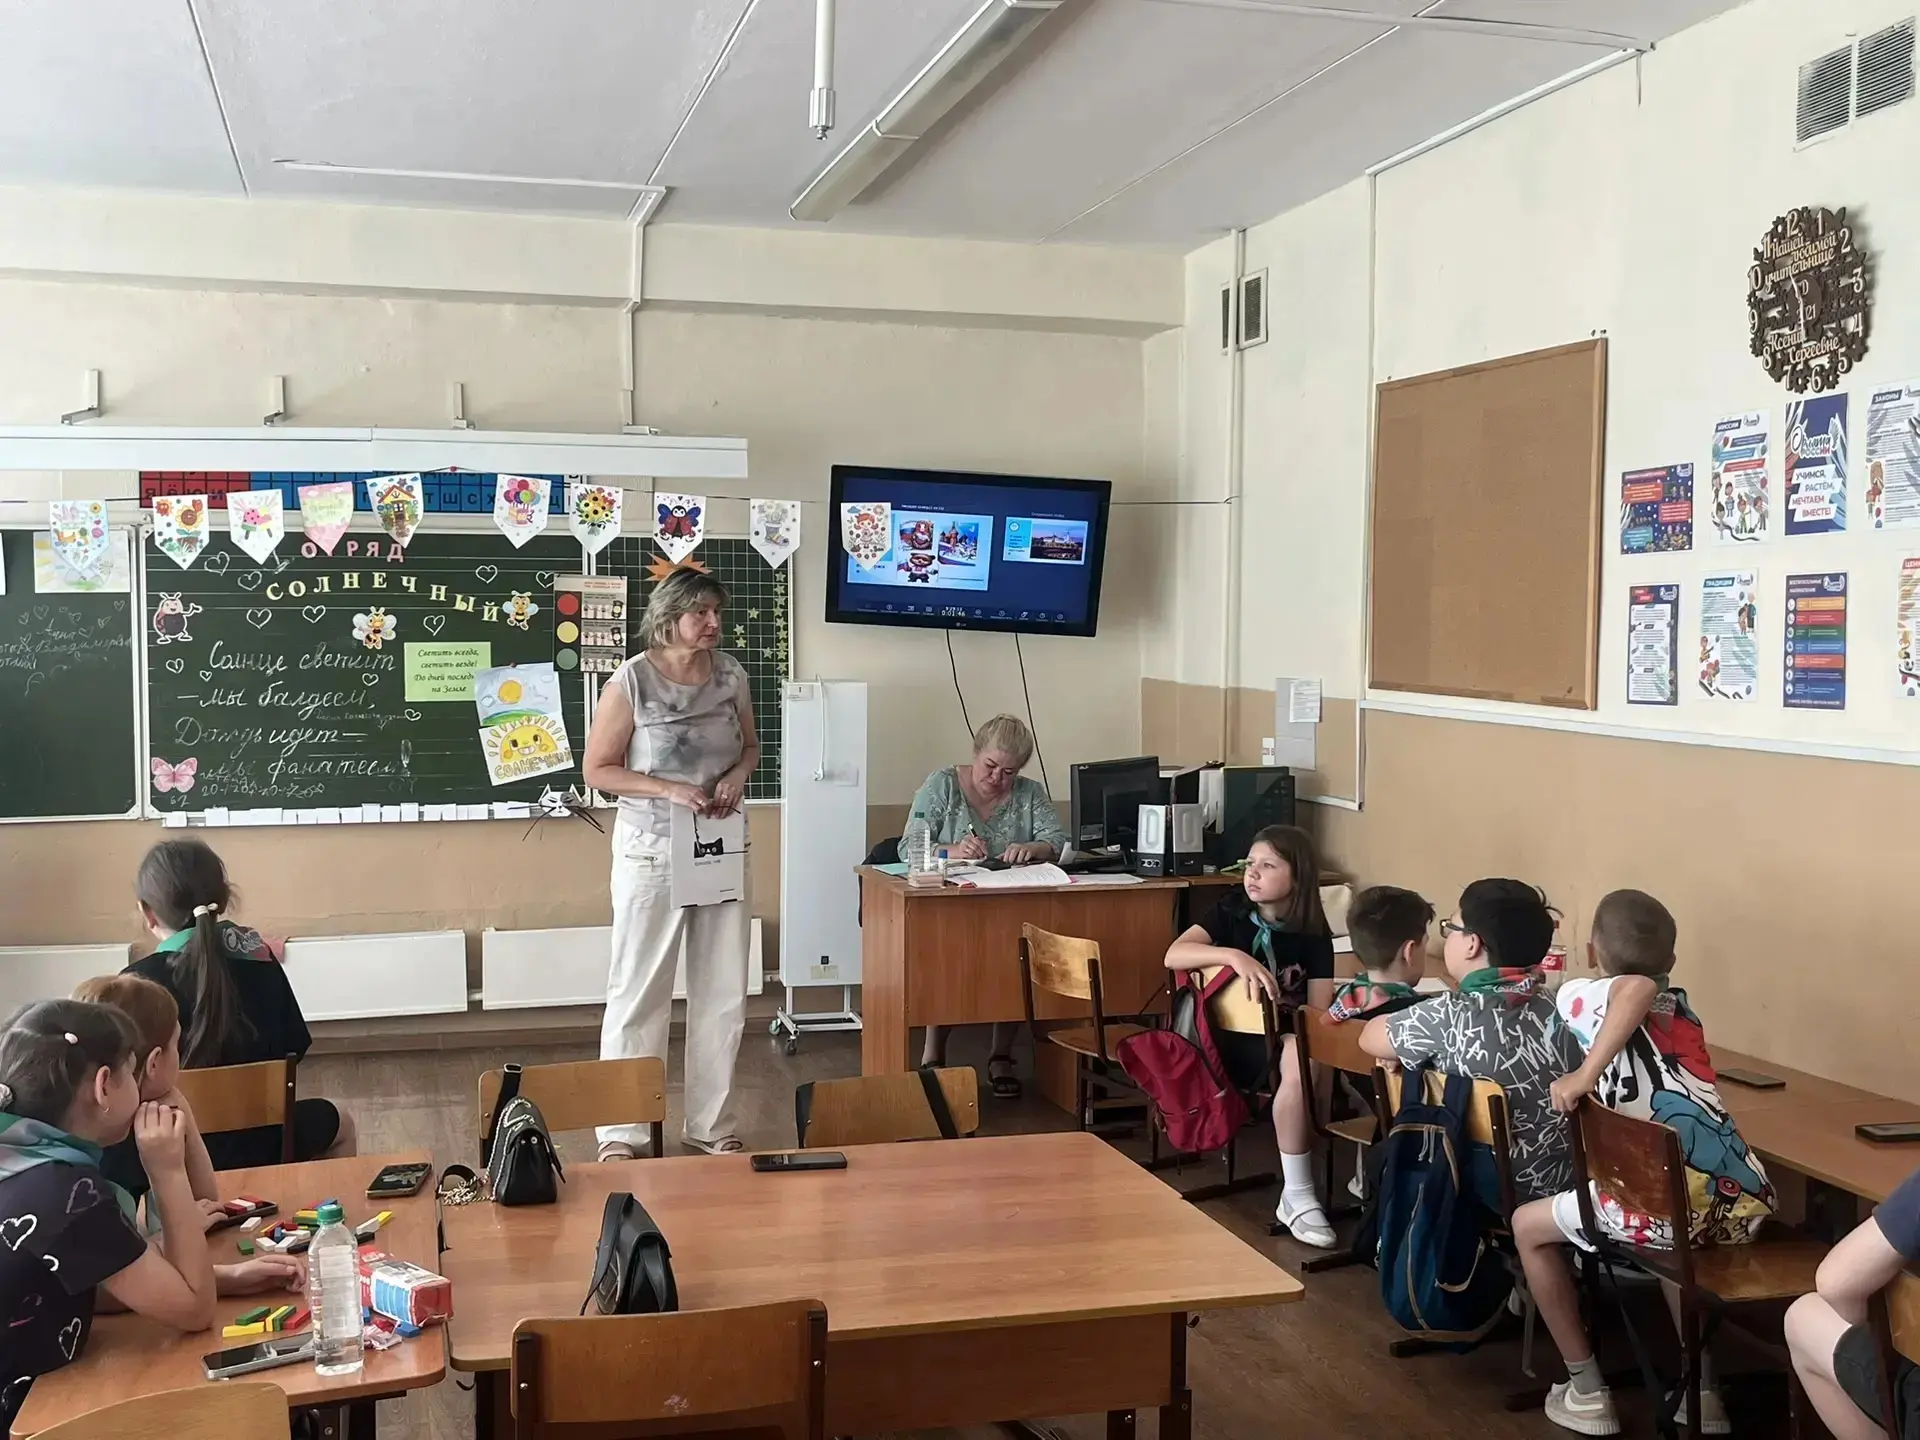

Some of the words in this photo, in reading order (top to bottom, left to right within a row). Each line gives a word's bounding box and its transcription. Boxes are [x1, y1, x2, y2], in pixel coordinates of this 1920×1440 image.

[1786, 211, 1798, 237] 12
[1816, 208, 1824, 236] 1
[1762, 233, 1772, 260] 11
[1772, 232, 1804, 259] Нашей
[1840, 228, 1851, 253] 2
[1748, 266, 1762, 293] 10
[1764, 248, 1836, 291] учительнице
[1852, 268, 1864, 294] 3
[1748, 308, 1758, 334] 9
[1853, 312, 1864, 338] 4
[1762, 344, 1772, 371] 8
[1786, 336, 1840, 370] Сергеевне
[1838, 347, 1848, 373] 5
[1783, 364, 1792, 389] 7
[1810, 366, 1822, 393] 6
[1875, 392, 1900, 403] ЗАКОНЫ
[1796, 470, 1826, 480] УЧИМСЯ,
[1792, 495, 1825, 506] МЕЧТАЕМ
[301, 540, 405, 563] ОРЯД
[1905, 560, 1920, 568] ЦЕН
[266, 572, 499, 622] СОЛНЕЧНЫЙ
[210, 640, 288, 676] Солнце
[299, 642, 397, 672] светит
[418, 648, 452, 657] Светить
[420, 660, 454, 668] светить
